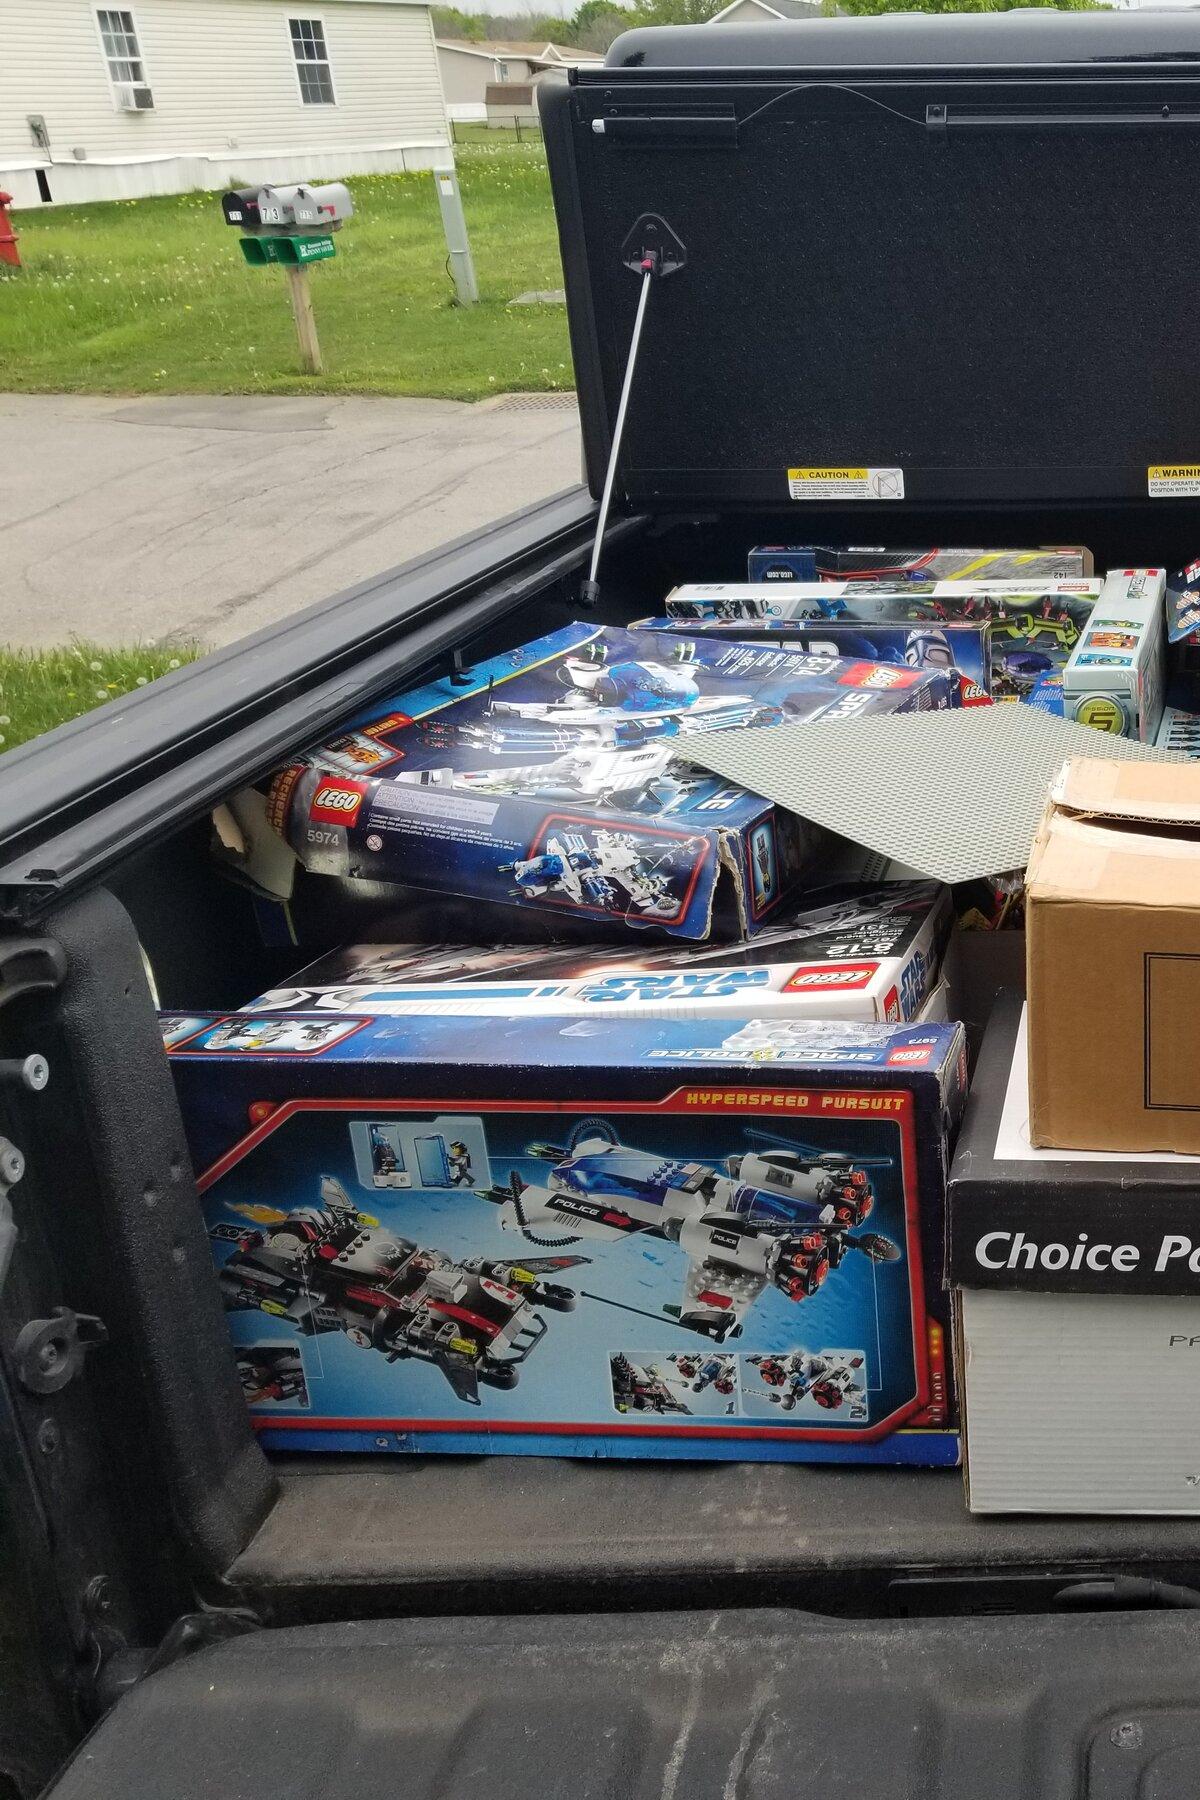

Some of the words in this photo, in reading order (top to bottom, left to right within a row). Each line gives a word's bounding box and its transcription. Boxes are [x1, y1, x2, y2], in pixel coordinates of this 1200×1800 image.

[809, 471, 849, 479] CAUTION
[862, 667, 903, 688] LEGO
[314, 787, 362, 812] LEGO
[306, 829, 340, 847] 5974
[826, 942, 895, 955] 8-12
[598, 969, 773, 988] WARS
[787, 970, 874, 985] LEGO
[576, 985, 745, 1003] STAR
[646, 1049, 756, 1060] POLICE
[785, 1050, 879, 1061] SPACE
[890, 1049, 931, 1062] LEGO
[686, 1093, 809, 1107] HYPERSPEED
[821, 1096, 905, 1111] PURSUIT
[554, 1198, 600, 1217] POLICE
[713, 1234, 737, 1245] POLICE
[974, 1230, 1141, 1273] Choice
[725, 1401, 736, 1416] 1
[850, 1405, 864, 1419] 2
